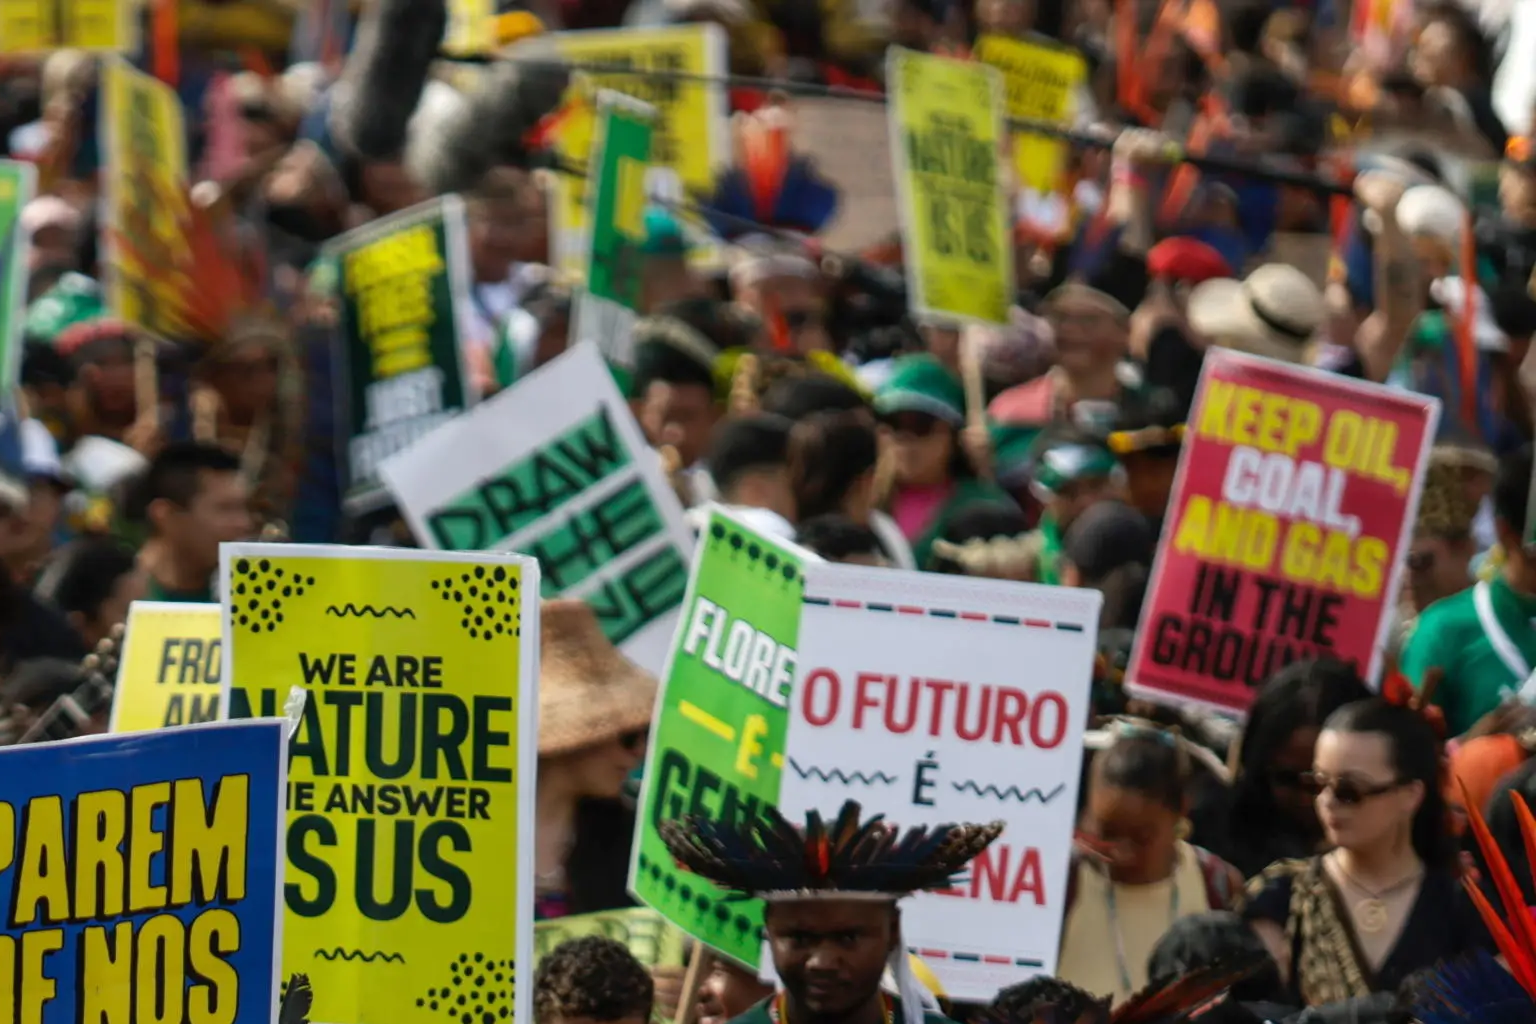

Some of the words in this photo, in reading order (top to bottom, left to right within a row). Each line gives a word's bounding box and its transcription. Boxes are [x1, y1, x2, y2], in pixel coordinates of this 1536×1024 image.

[428, 402, 626, 551] DRAW
[1197, 378, 1323, 457] KEEP
[1322, 408, 1412, 496] OIL,
[534, 473, 661, 594] HE
[1221, 444, 1362, 538] COAL,
[1173, 493, 1279, 572] AND
[1281, 520, 1389, 598] GAS
[1189, 560, 1242, 622] IN
[1255, 574, 1345, 648] THE
[155, 637, 222, 686] FRO
[299, 652, 357, 686] WE
[365, 655, 444, 688] ARE
[683, 596, 799, 709] FLORE
[734, 713, 768, 780] É
[801, 667, 842, 728] O
[851, 670, 1070, 751] FUTURO
[324, 782, 492, 820] ANSWER
[912, 750, 940, 807] É
[283, 814, 339, 918] S
[353, 818, 474, 925] US
